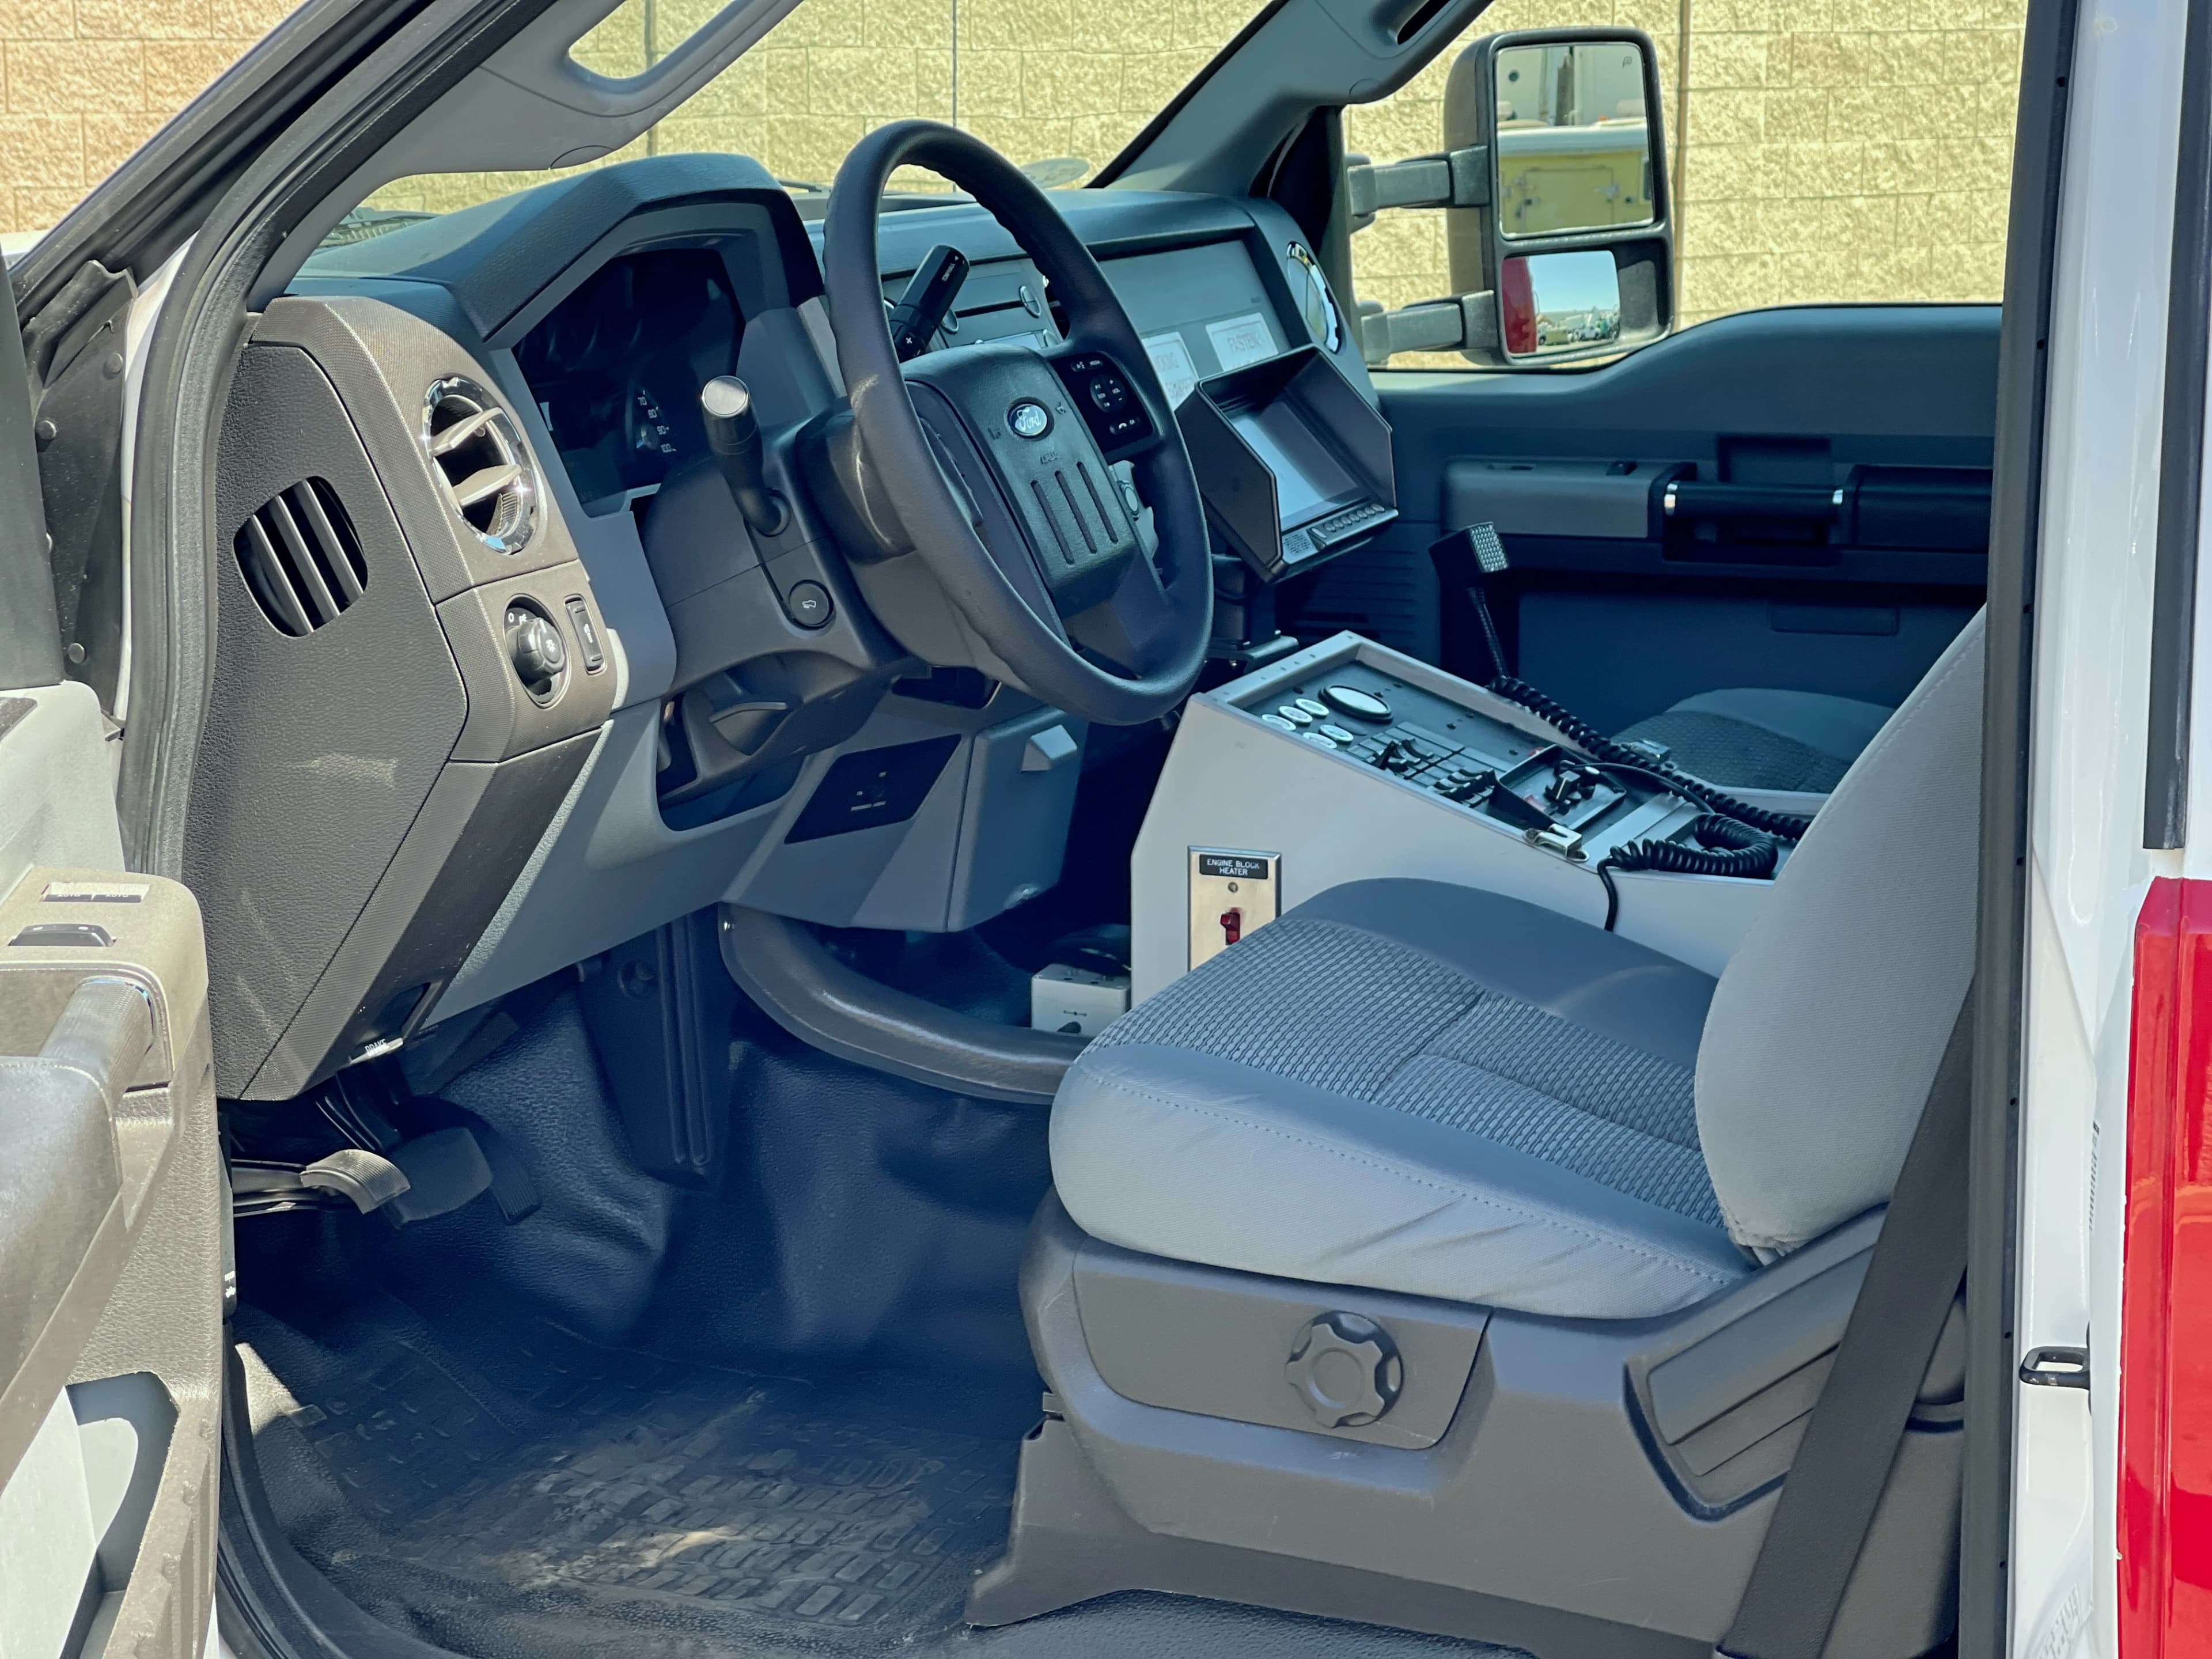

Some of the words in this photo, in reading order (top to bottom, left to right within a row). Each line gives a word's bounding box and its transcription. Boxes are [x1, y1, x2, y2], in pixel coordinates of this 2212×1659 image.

[638, 396, 647, 406] 70
[647, 408, 657, 418] 80
[1015, 406, 1042, 431] Ford
[657, 425, 666, 435] 90
[1207, 858, 1233, 867] ENGINE
[1235, 861, 1260, 869] BLOCK
[1219, 867, 1248, 876] HEATER
